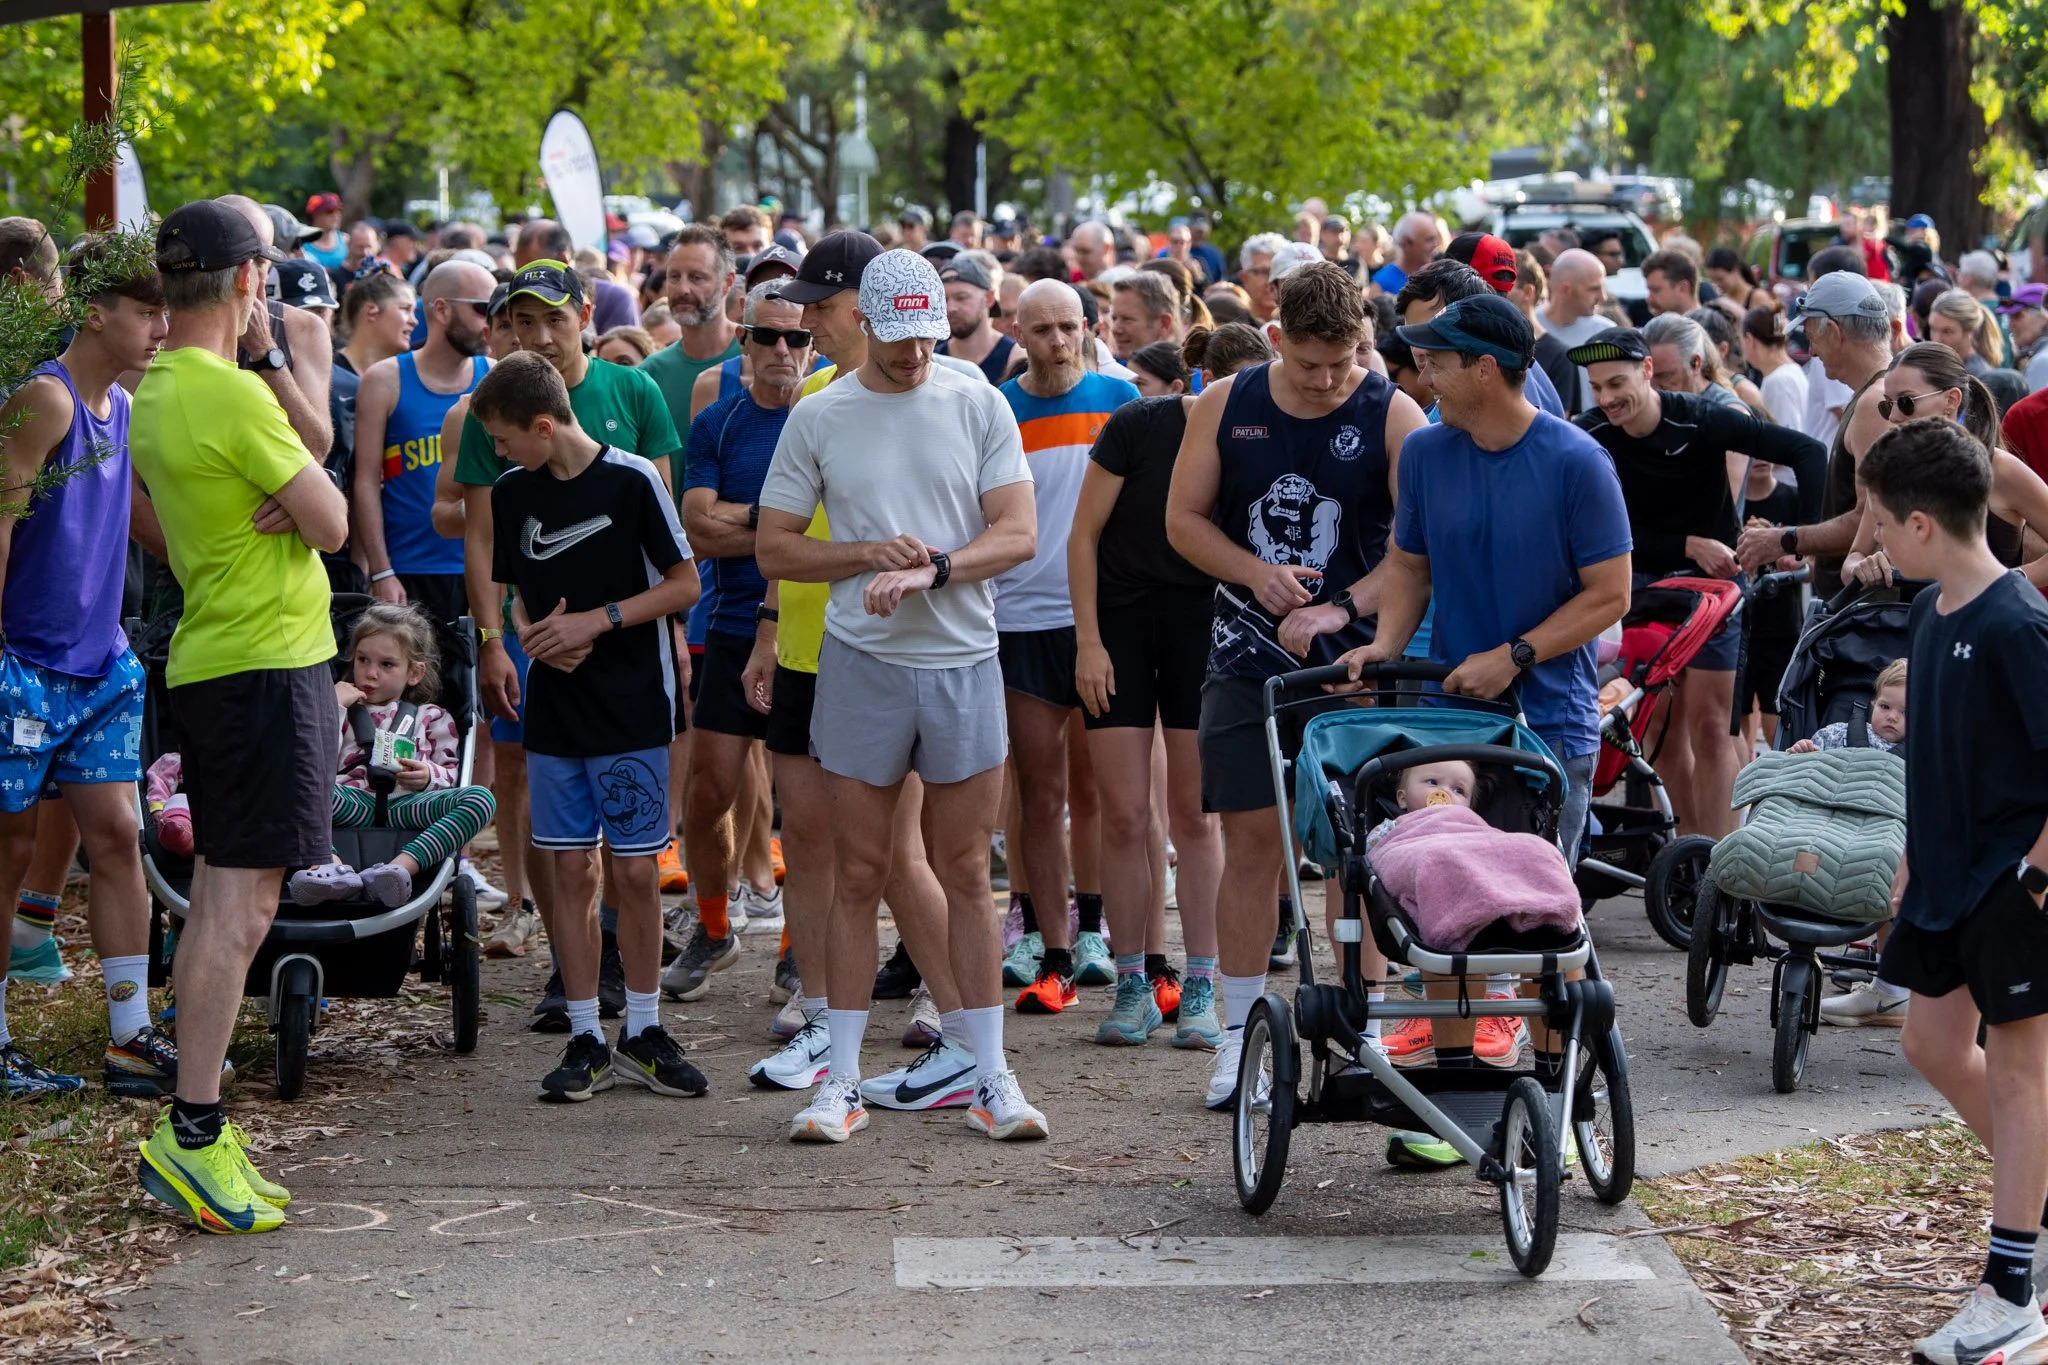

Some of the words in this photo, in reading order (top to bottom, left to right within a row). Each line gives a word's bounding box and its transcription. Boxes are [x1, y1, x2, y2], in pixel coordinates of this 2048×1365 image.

[524, 270, 546, 280] FIXX
[897, 297, 925, 308] rnnr
[1235, 428, 1263, 436] PATLIN
[1408, 1035, 1425, 1046] new
